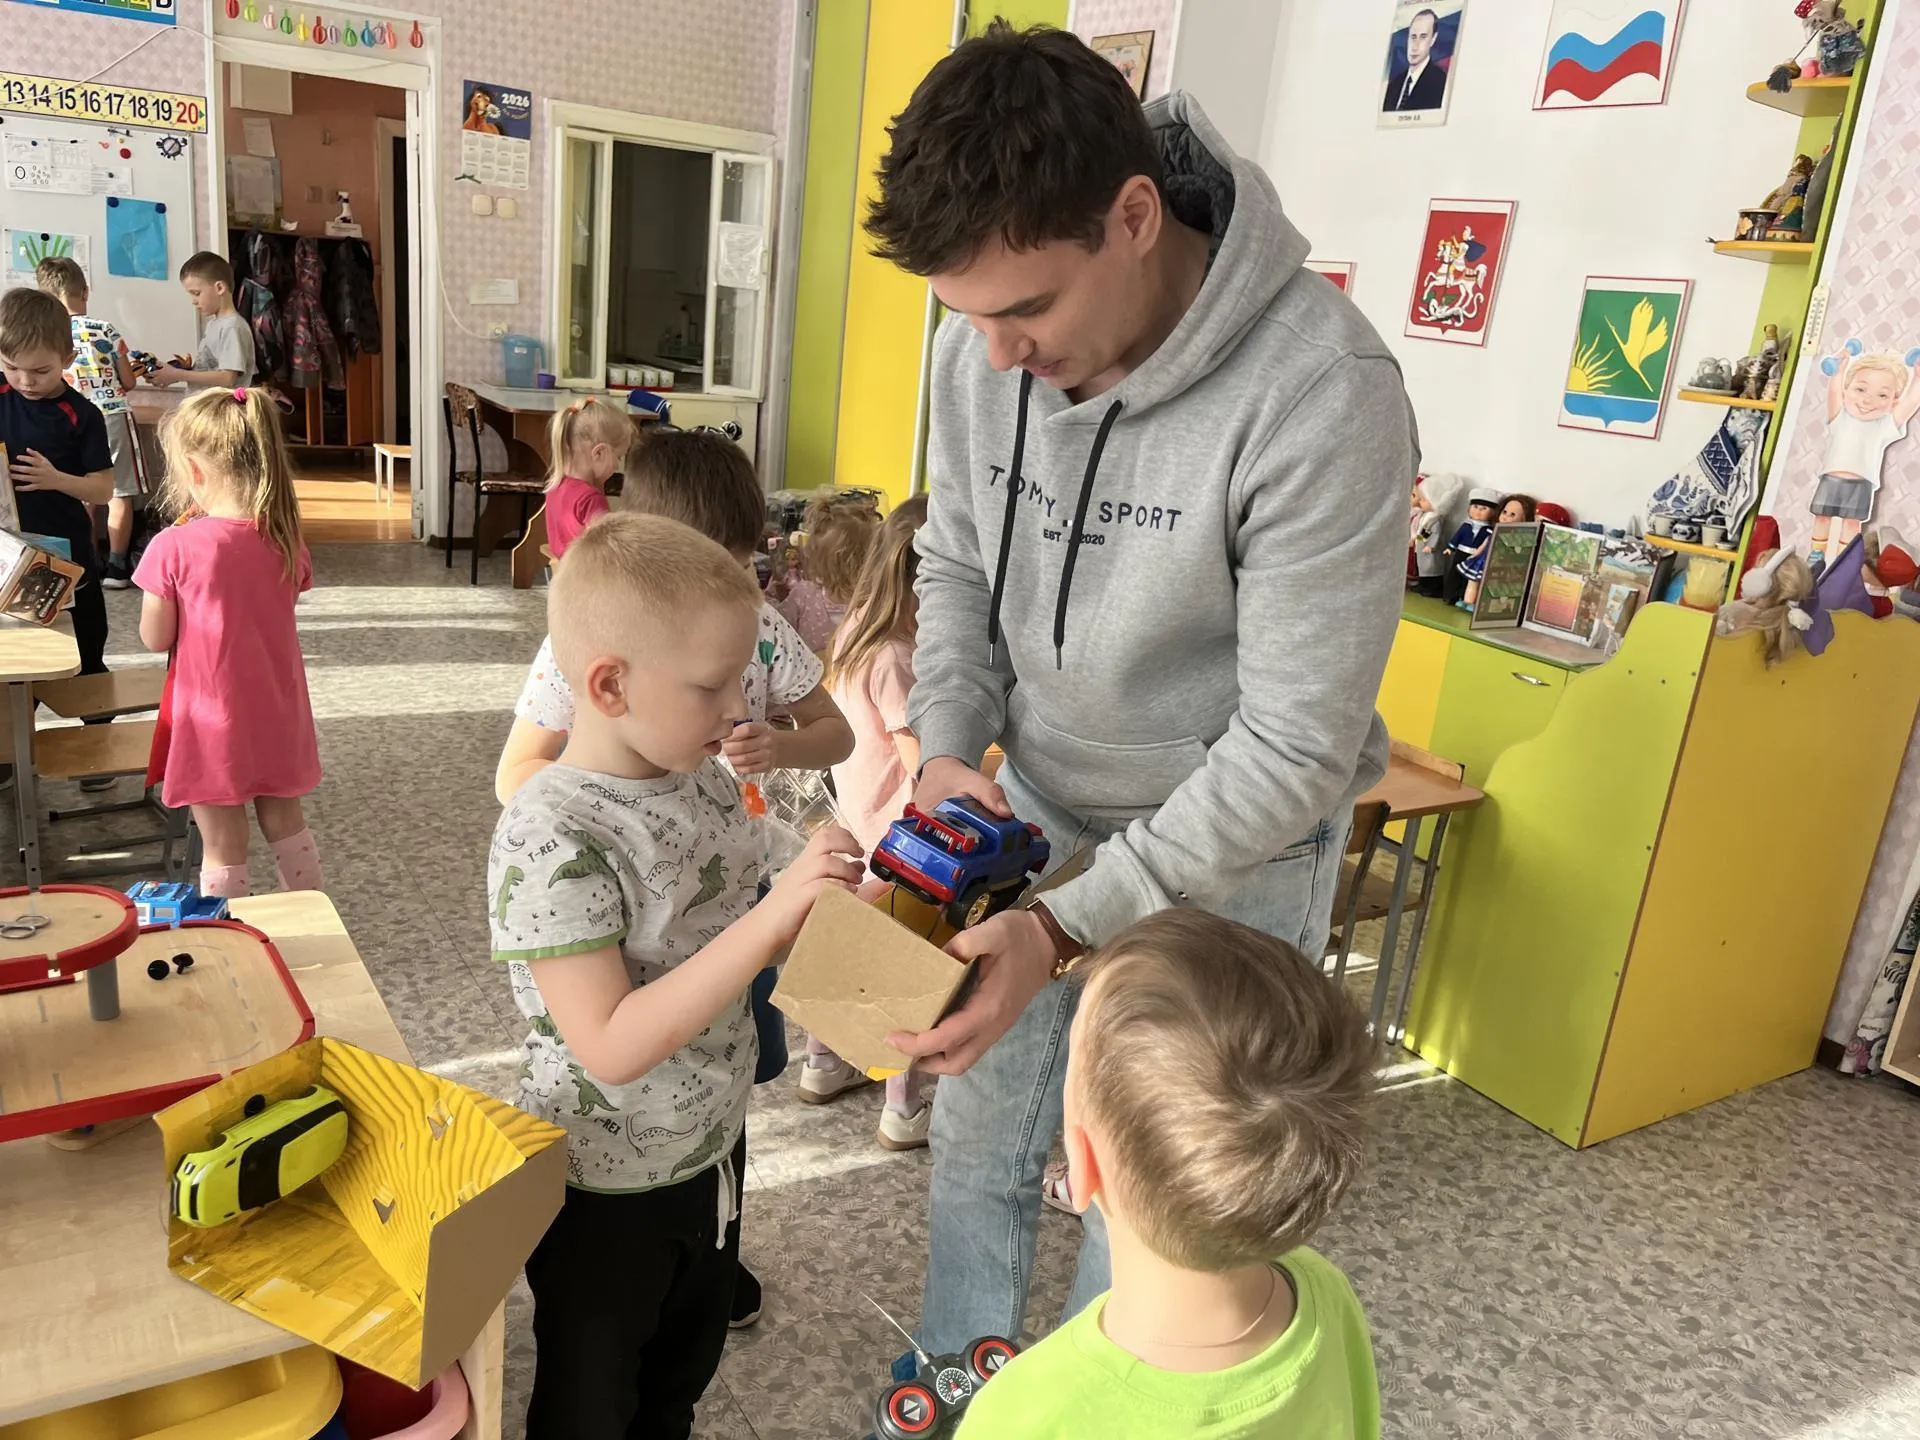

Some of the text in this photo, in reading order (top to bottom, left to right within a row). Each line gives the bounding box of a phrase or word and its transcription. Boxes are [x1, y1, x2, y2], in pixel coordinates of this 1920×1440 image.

[3, 80, 199, 125] 13 14 15 16 17 18 19 20
[501, 93, 530, 107] 2026
[1099, 501, 1181, 531] SPORT
[1080, 533, 1105, 545] 2020
[527, 839, 559, 863] T-REX
